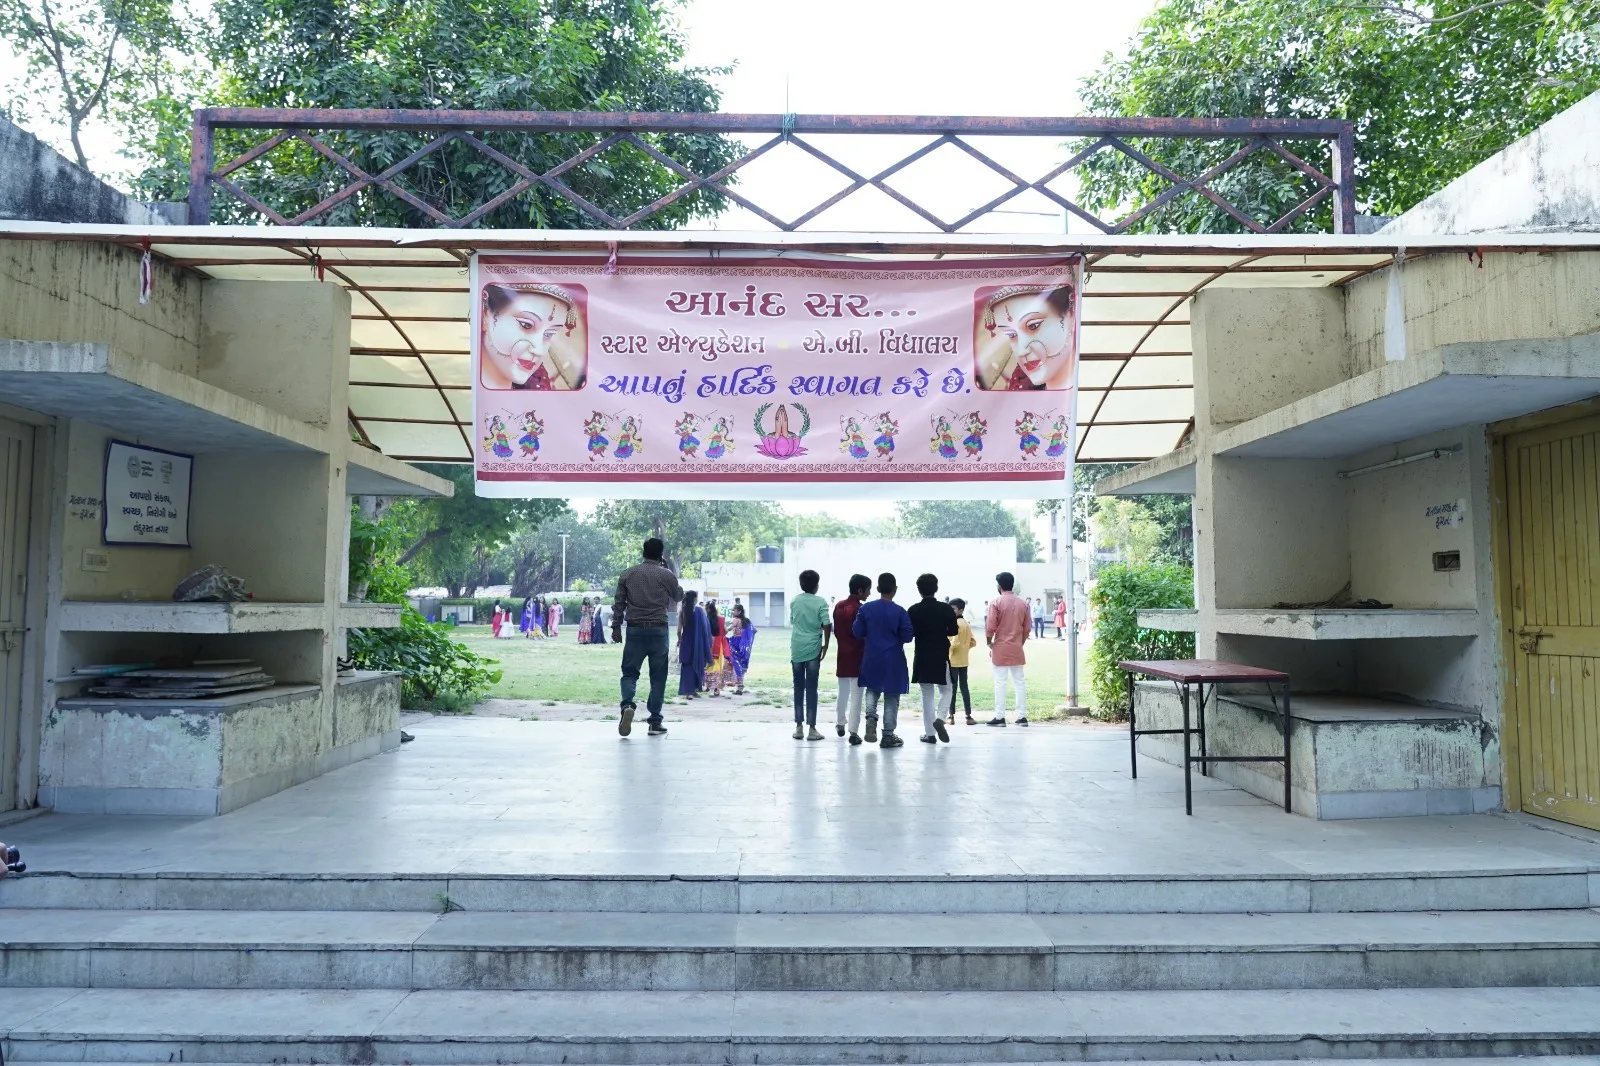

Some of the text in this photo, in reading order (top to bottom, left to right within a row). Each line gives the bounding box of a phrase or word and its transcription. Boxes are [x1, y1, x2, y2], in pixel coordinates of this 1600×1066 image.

[665, 284, 918, 318] આનંદ સર...
[600, 327, 765, 362] સ્ટાર એજ્યુકેશન
[802, 329, 868, 354] એ.બી.
[598, 364, 971, 404] આપનું હાર્દિક સ્વાગત કરે છે.
[128, 489, 152, 501] આપણો
